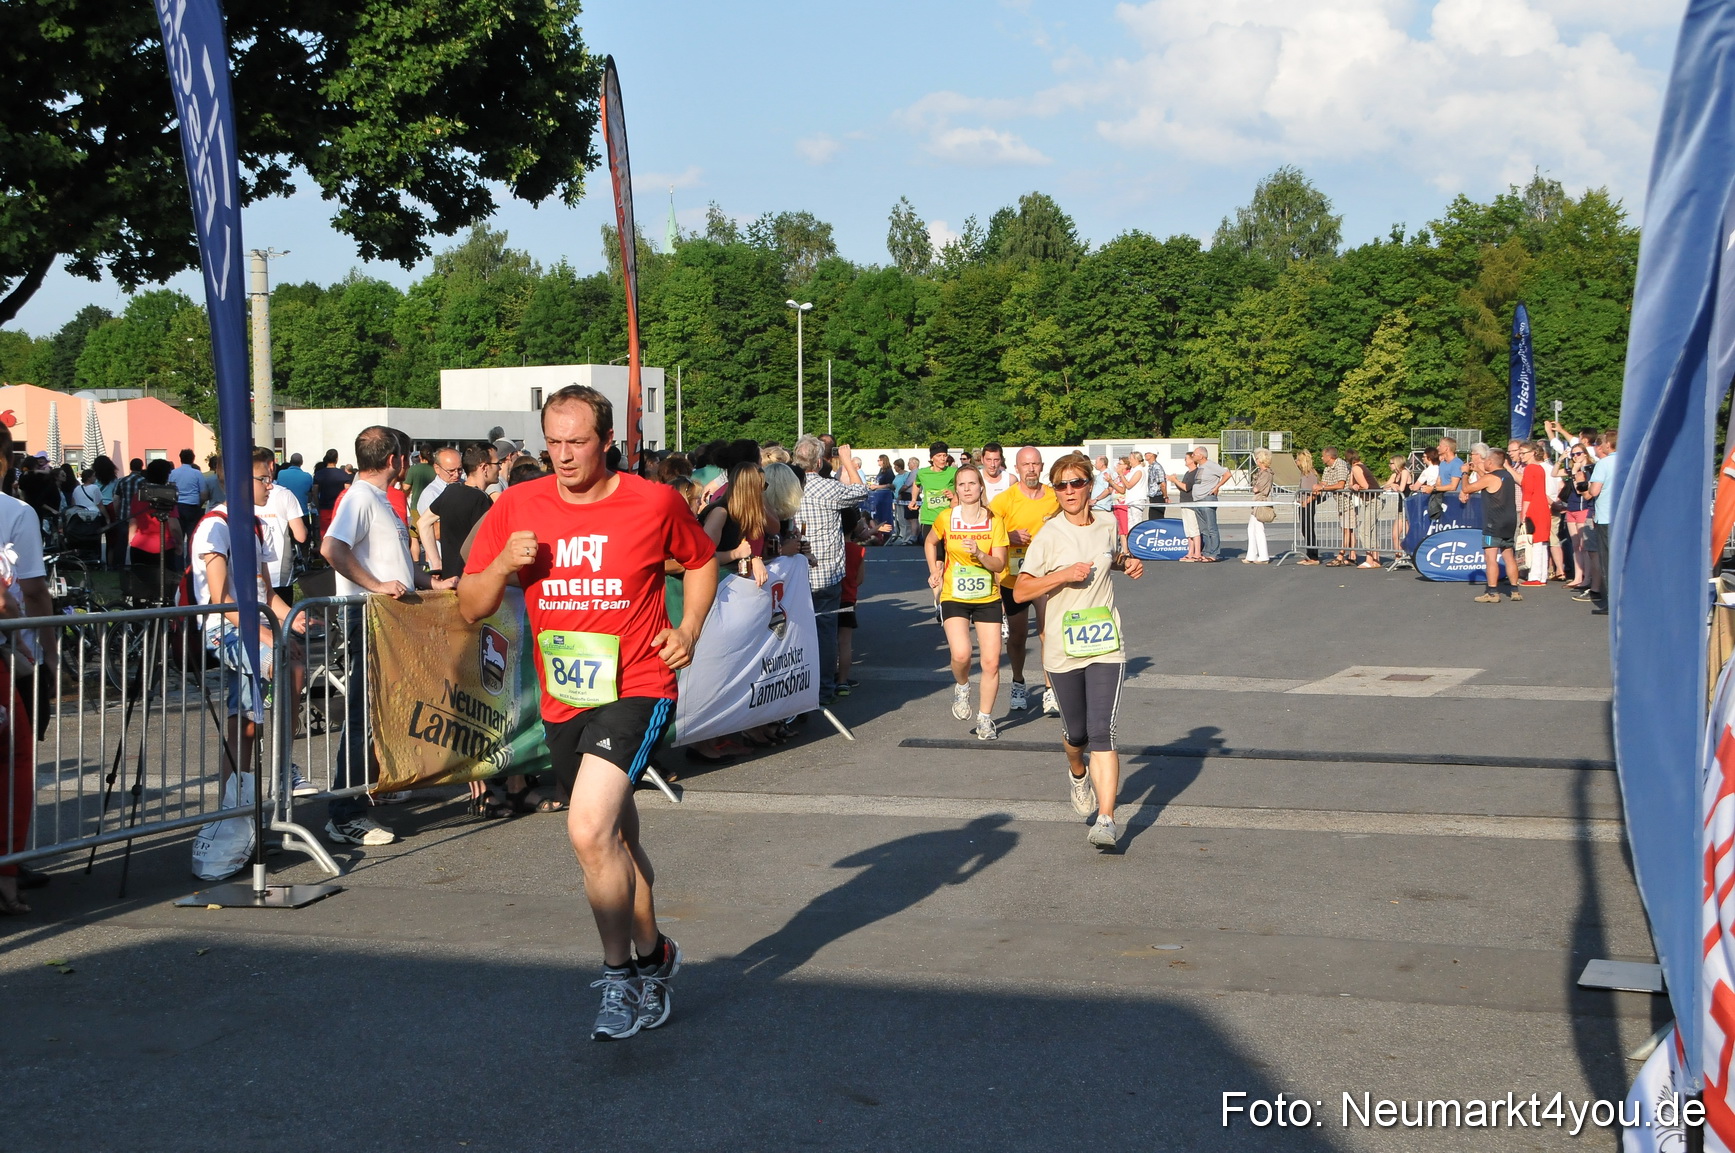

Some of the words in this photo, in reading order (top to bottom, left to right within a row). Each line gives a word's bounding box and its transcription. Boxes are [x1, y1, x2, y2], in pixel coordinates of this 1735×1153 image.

[1427, 519, 1472, 535] Fisch
[555, 534, 609, 573] MRT
[1440, 551, 1502, 564] Fischr
[541, 578, 623, 596] MEIER
[957, 577, 986, 592] 835
[538, 598, 590, 610] Running
[591, 598, 631, 610] Team
[1064, 622, 1115, 645] 1422
[760, 647, 804, 676] Neumarkter
[551, 657, 603, 689] 847
[749, 666, 811, 709] Lammsbräu
